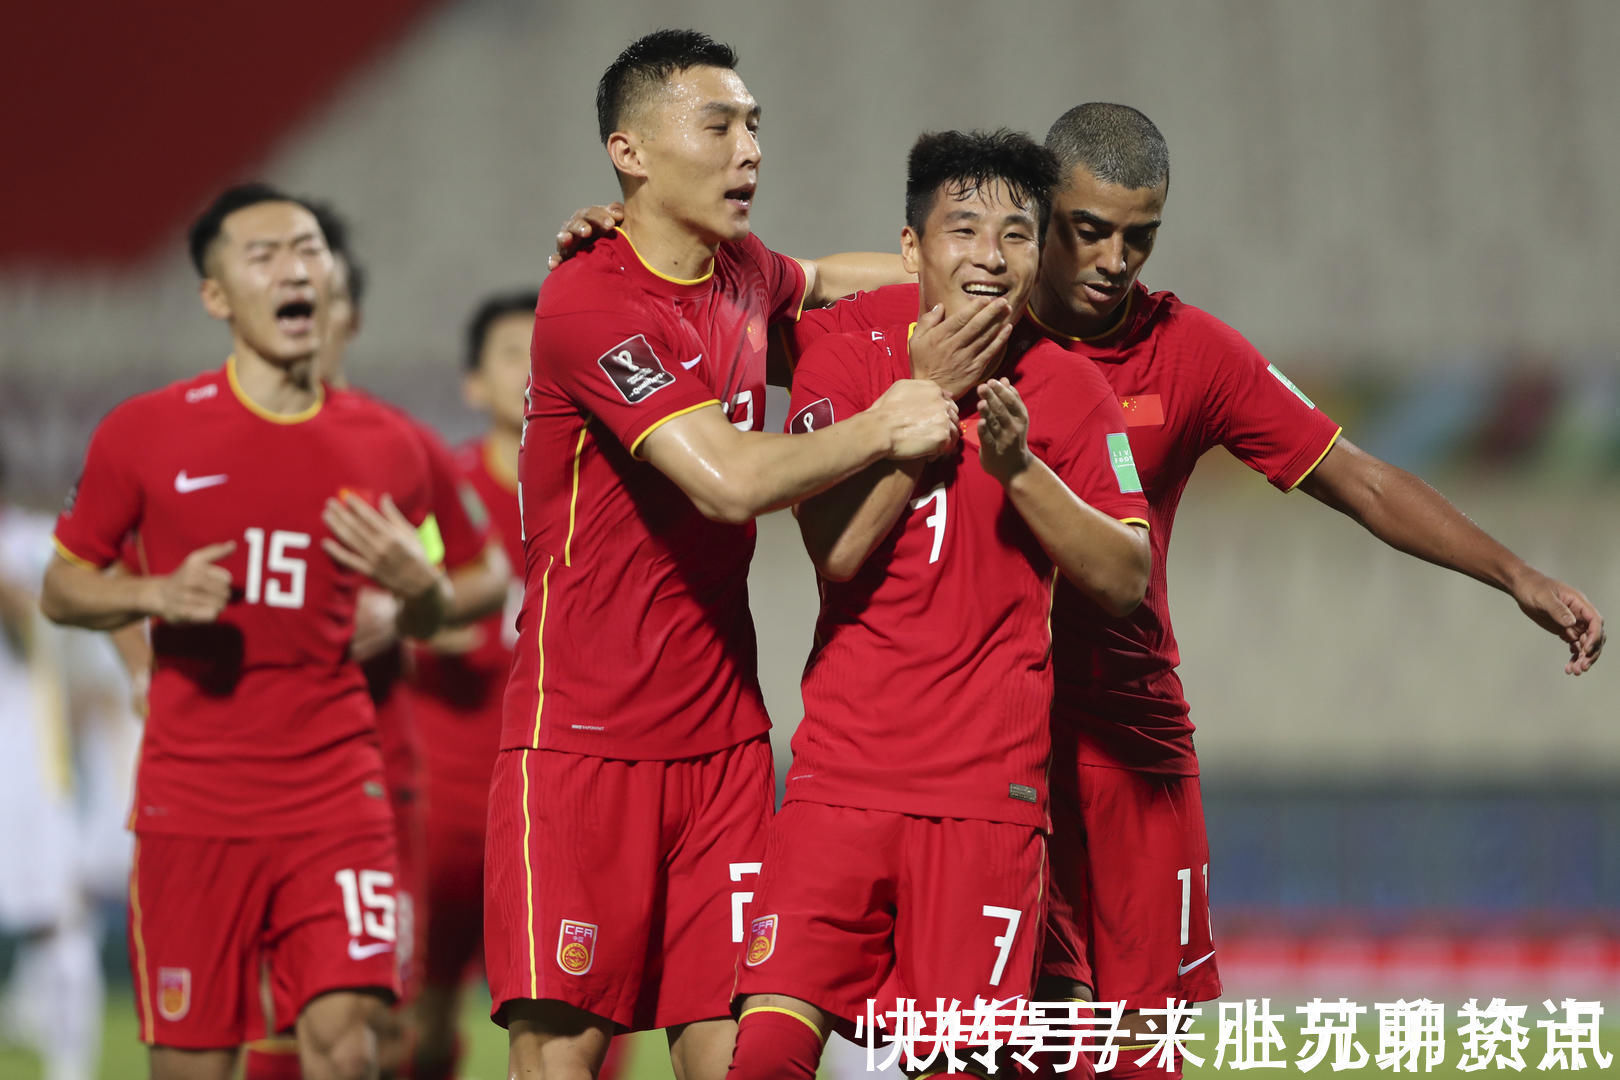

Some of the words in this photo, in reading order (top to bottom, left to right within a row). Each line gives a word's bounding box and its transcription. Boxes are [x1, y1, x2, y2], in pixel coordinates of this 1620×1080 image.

[910, 482, 948, 564] 7
[245, 527, 311, 609] 15
[335, 868, 396, 942] 15
[565, 924, 593, 939] CFA
[983, 904, 1022, 987] 7
